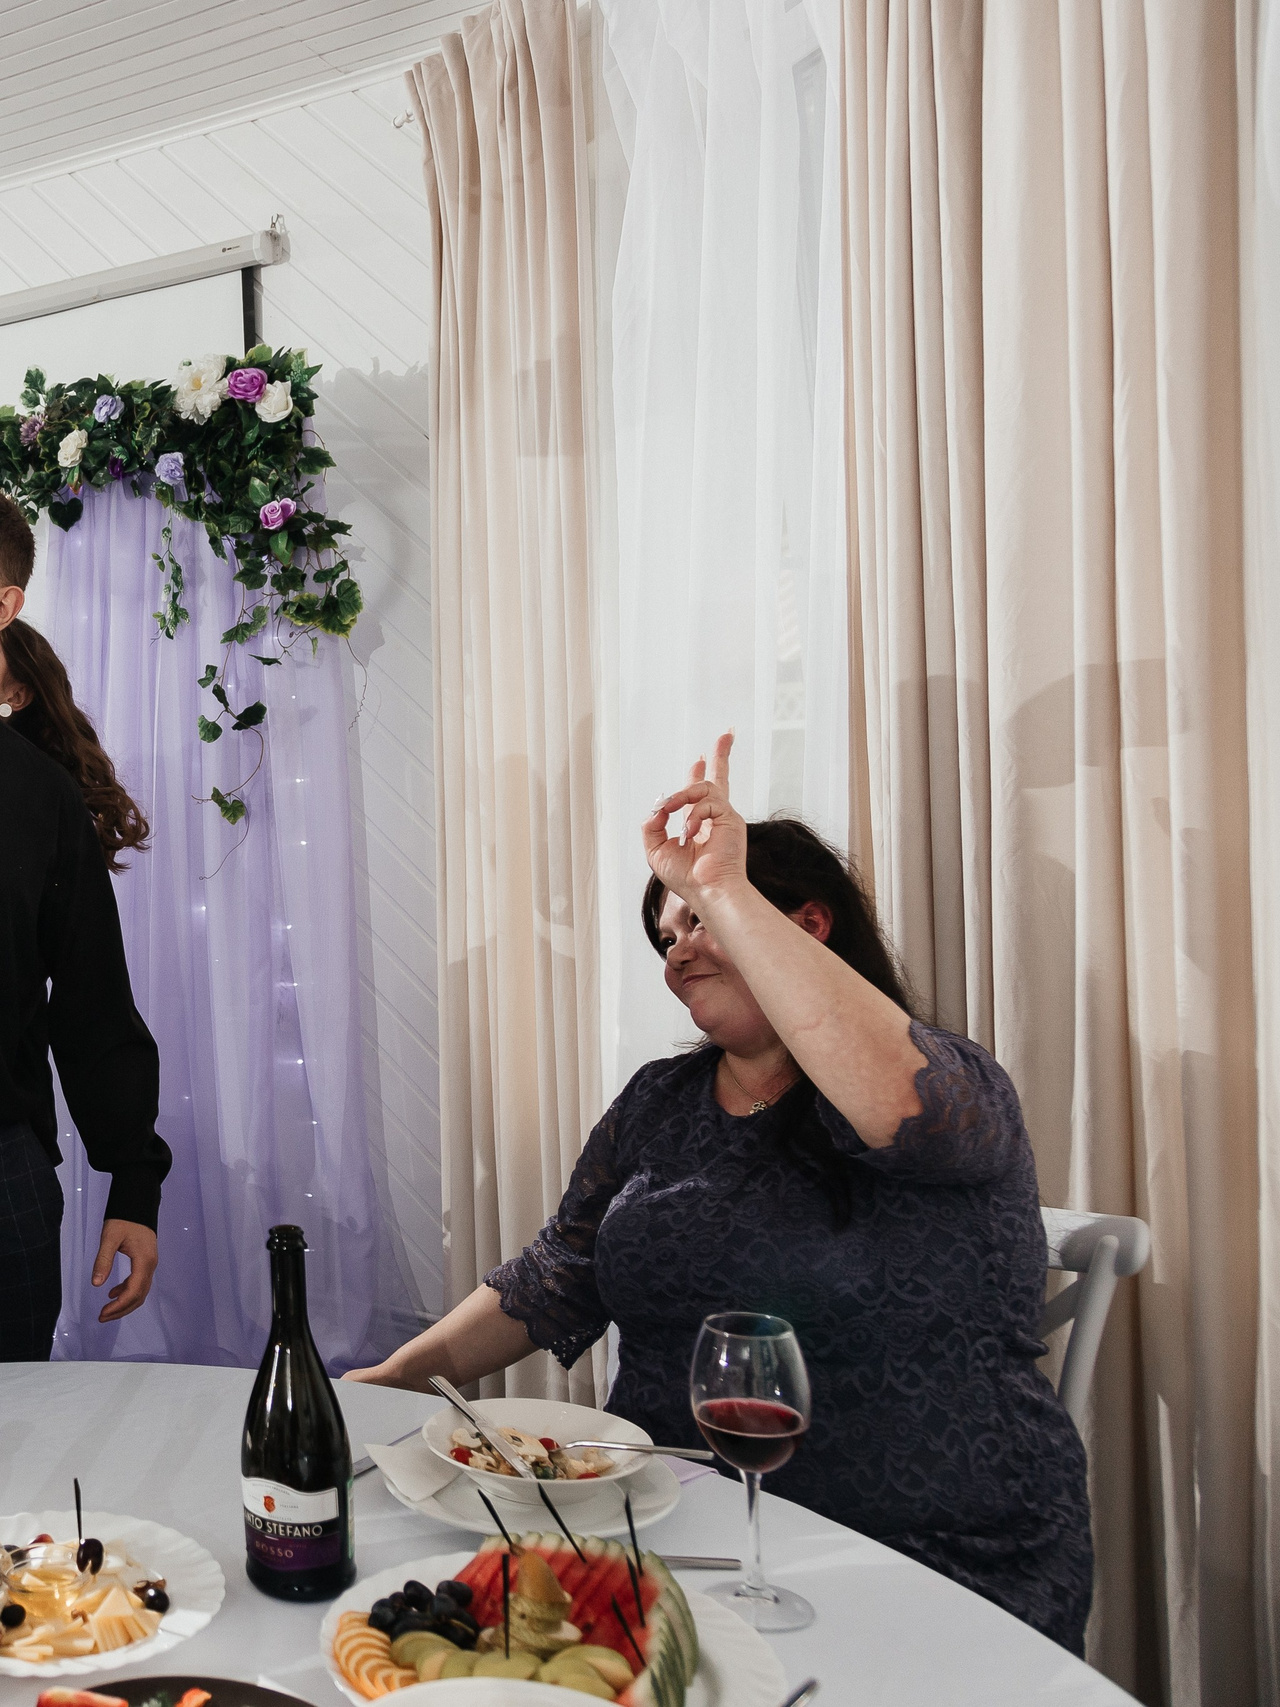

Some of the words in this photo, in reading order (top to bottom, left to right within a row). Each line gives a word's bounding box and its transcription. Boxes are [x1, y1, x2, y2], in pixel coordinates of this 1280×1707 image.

[244, 1509, 263, 1529] NTO
[266, 1521, 323, 1537] STEFANO
[255, 1540, 294, 1558] ROSSO
